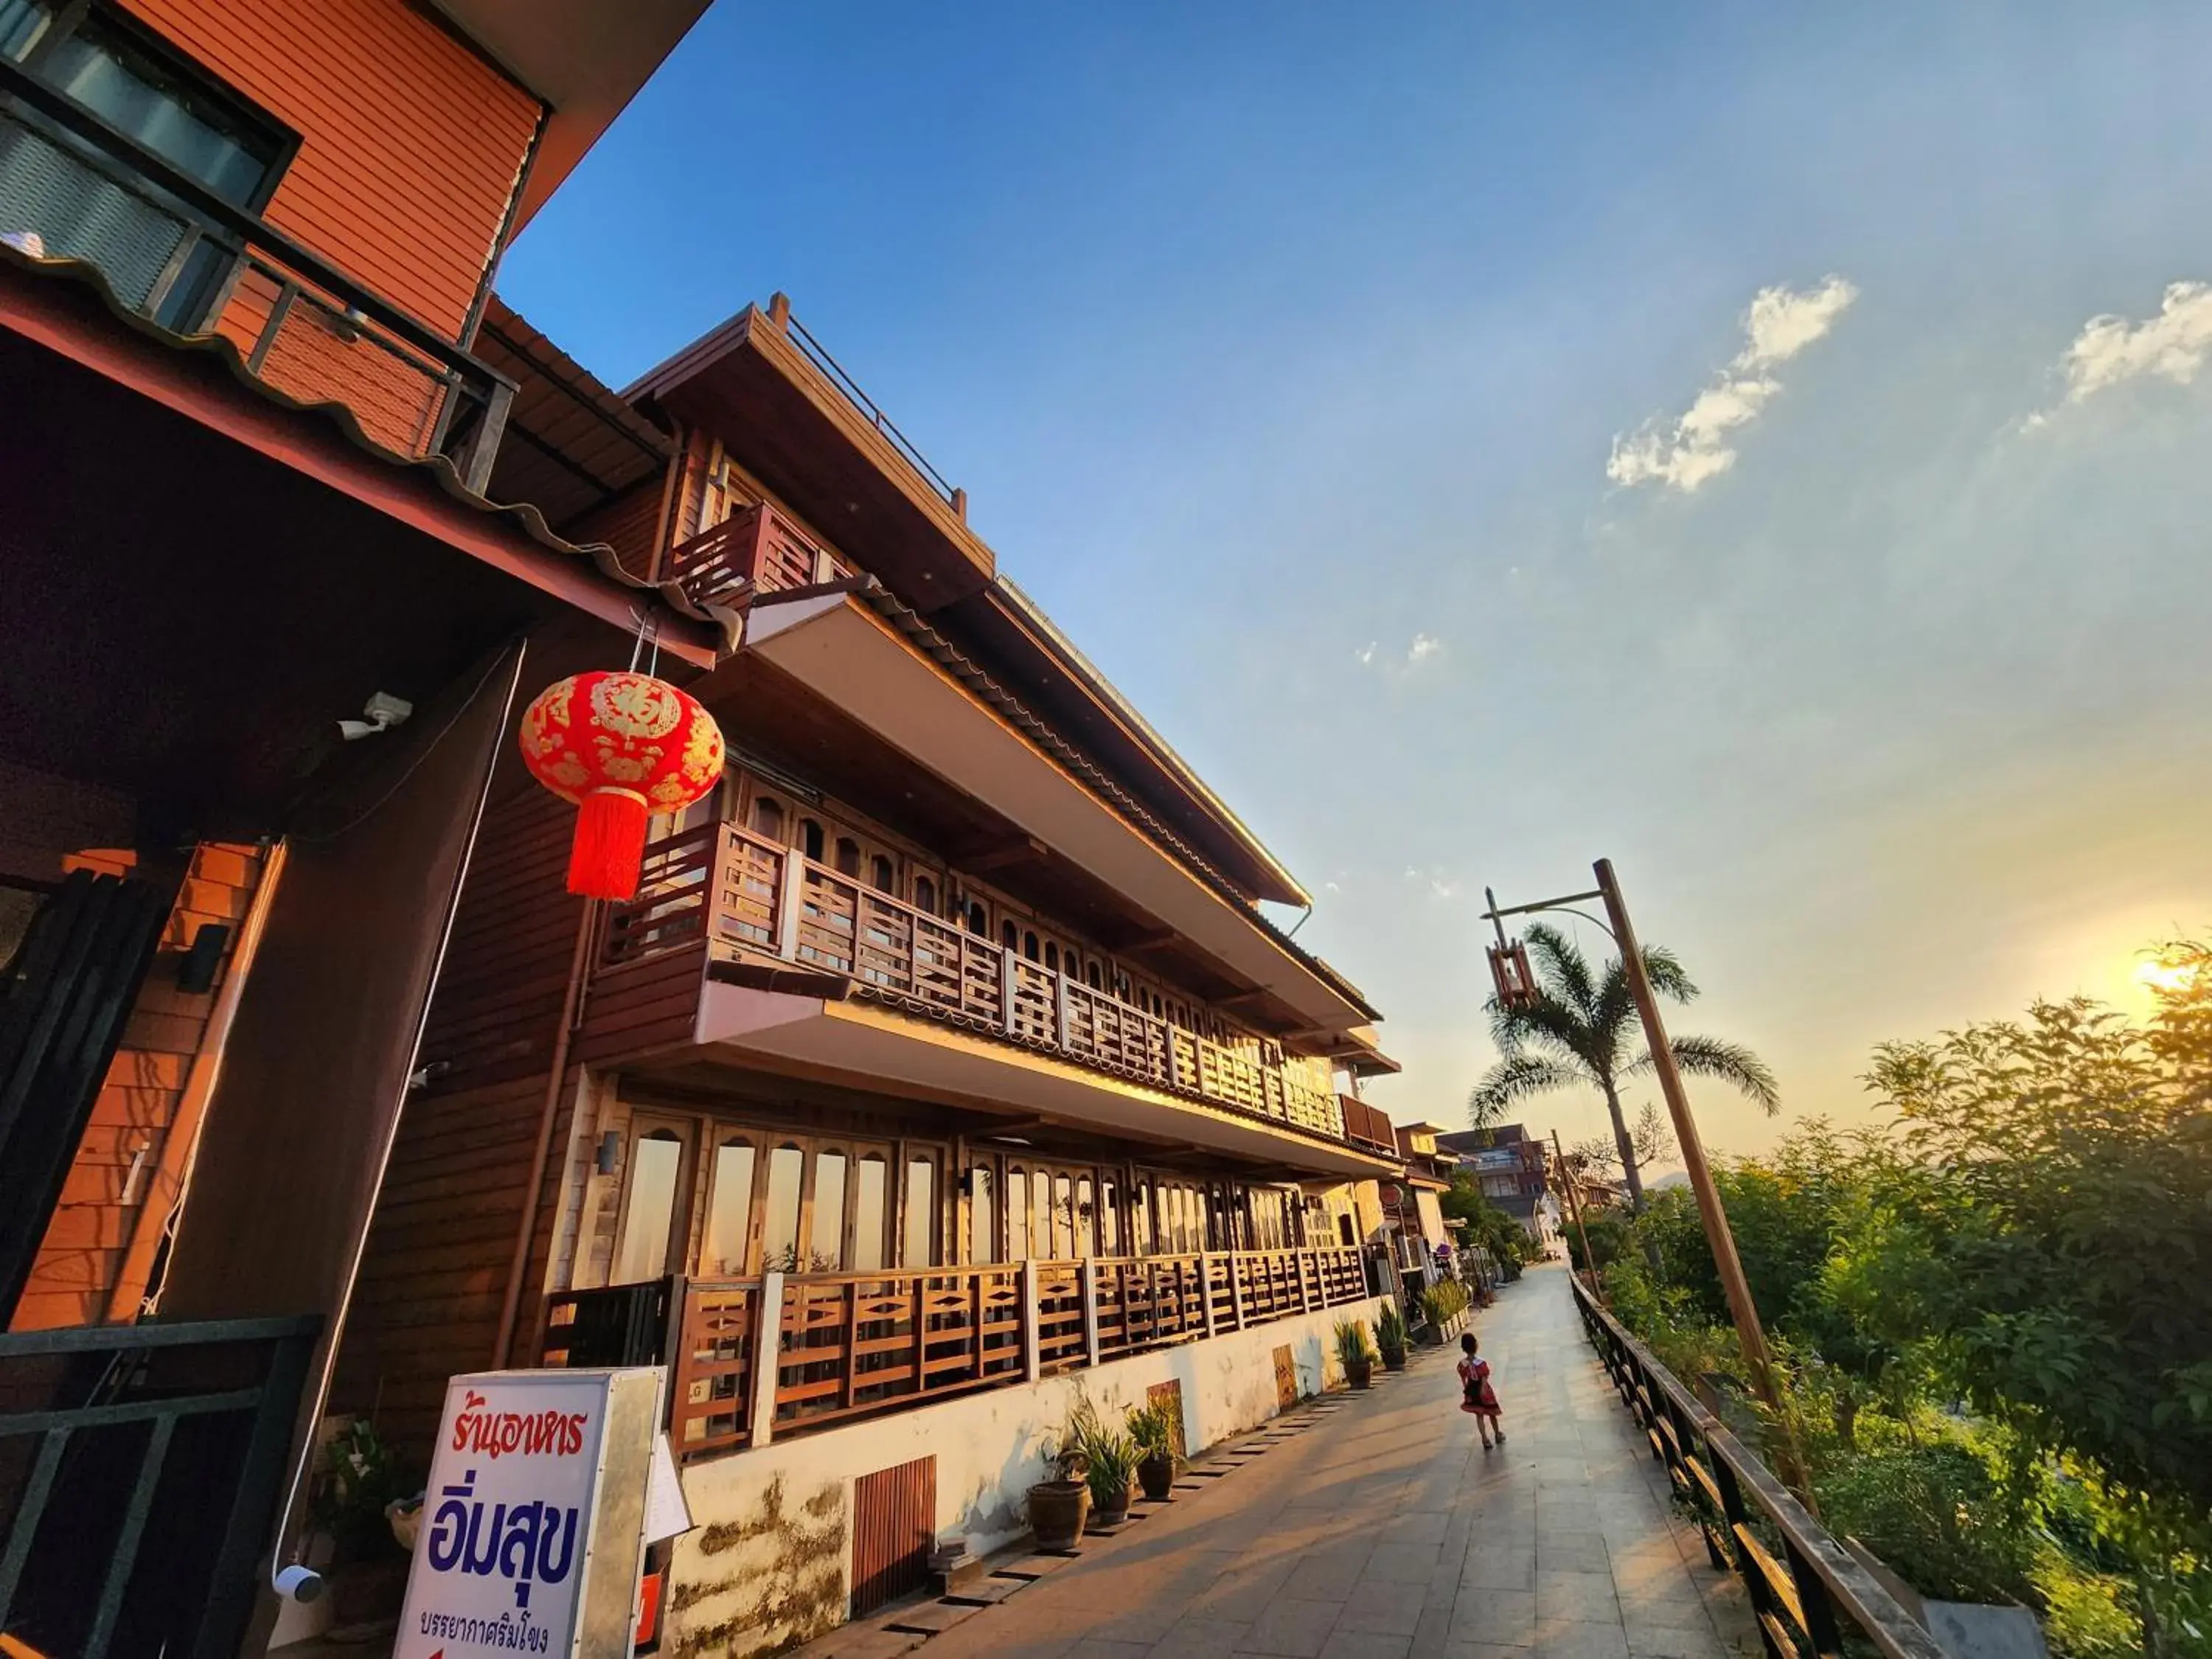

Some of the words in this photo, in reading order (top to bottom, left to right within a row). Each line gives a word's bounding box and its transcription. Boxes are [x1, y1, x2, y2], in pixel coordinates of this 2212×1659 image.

[452, 1390, 588, 1459] ร้านอาหาร
[428, 1470, 579, 1608] อิ่มสุข
[420, 1610, 549, 1654] บรรยากาศริมโขง
